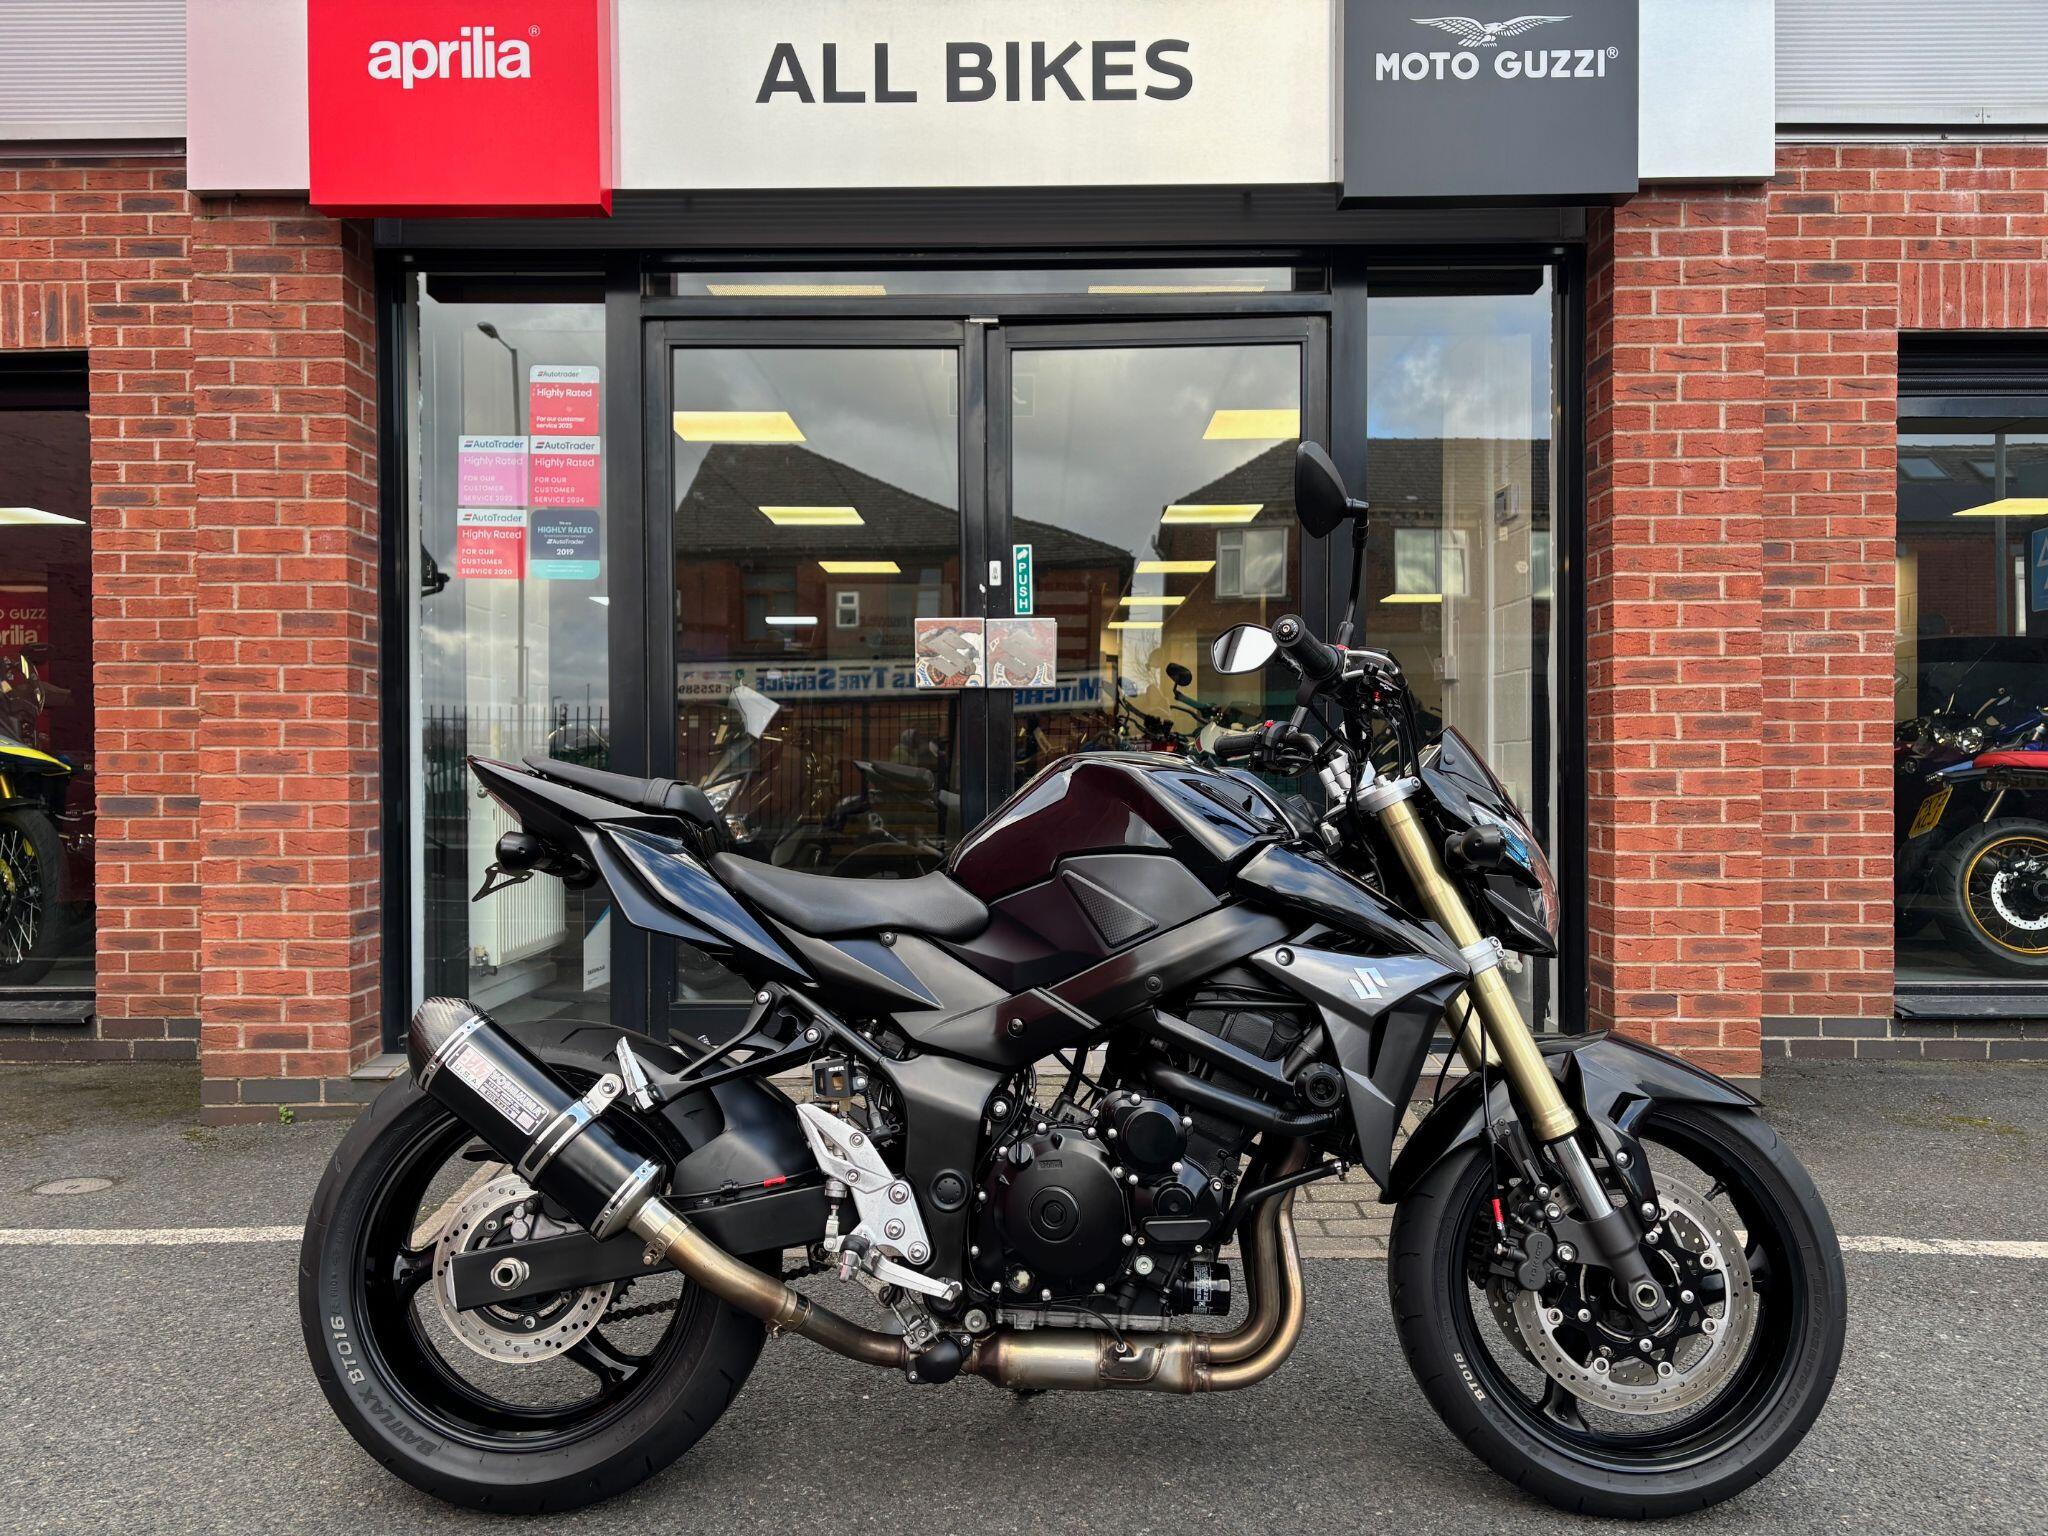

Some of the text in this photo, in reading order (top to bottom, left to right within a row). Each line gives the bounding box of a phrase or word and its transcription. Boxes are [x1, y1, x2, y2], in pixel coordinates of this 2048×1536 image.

[755, 38, 1193, 104] ALL BIKES
[1375, 51, 1480, 81] MOTO
[536, 388, 592, 398] Highly Rated
[473, 440, 524, 449] AutoTrader
[544, 441, 595, 450] AutoTrader
[463, 456, 523, 467] Highly Rated
[535, 458, 595, 468] Highly Rated
[471, 513, 523, 522] AutoTrader
[462, 529, 522, 540] Highly Rated
[537, 526, 594, 534] HIGHLY RATED
[556, 548, 574, 556] 2019
[1018, 562, 1029, 609] PUSH
[0, 624, 38, 646] rilia
[330, 1315, 367, 1385] BT016
[1454, 1352, 1486, 1402] BT016
